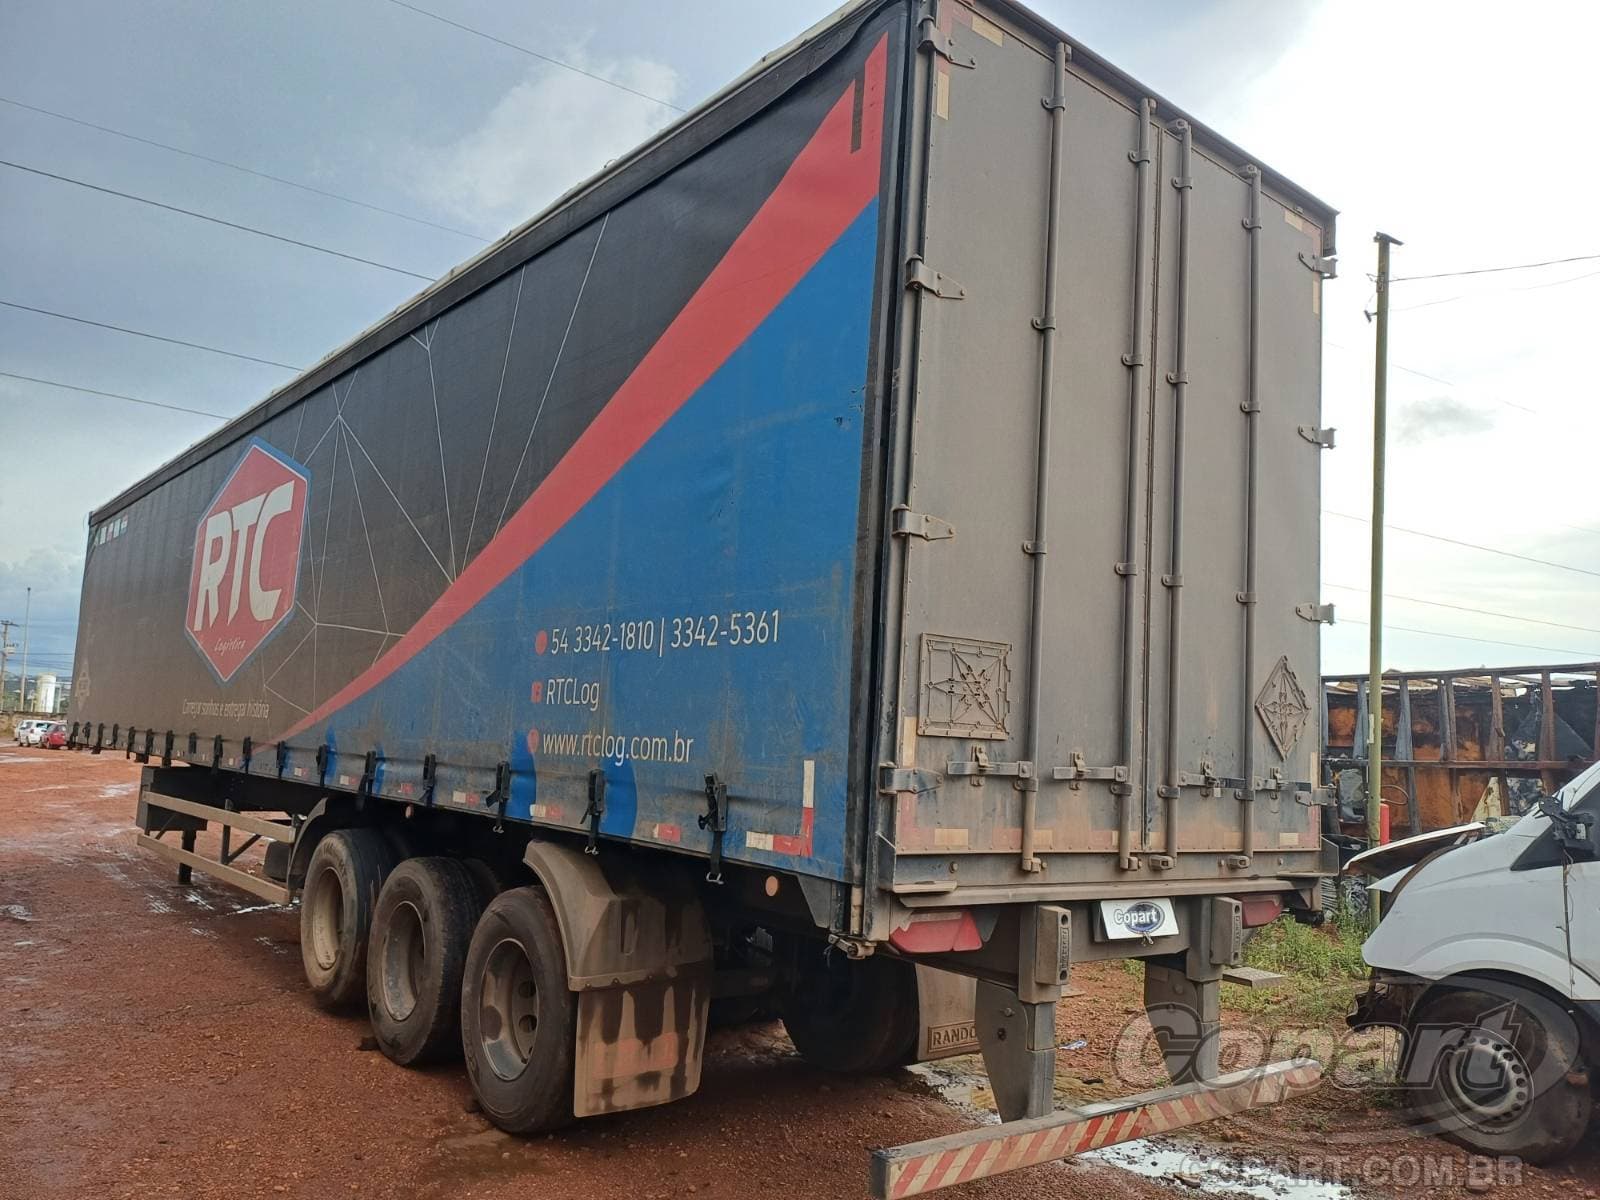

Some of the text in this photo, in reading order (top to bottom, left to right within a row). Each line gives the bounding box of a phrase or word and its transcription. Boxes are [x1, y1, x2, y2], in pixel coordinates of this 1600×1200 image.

[194, 480, 295, 632] RTC
[551, 628, 569, 655] 54
[573, 620, 654, 654] 3342-1810
[670, 609, 780, 649] 3342-5361
[546, 678, 600, 711] RTCLog
[542, 728, 695, 767] www.rtclog.com.br
[1114, 908, 1158, 927] Copart
